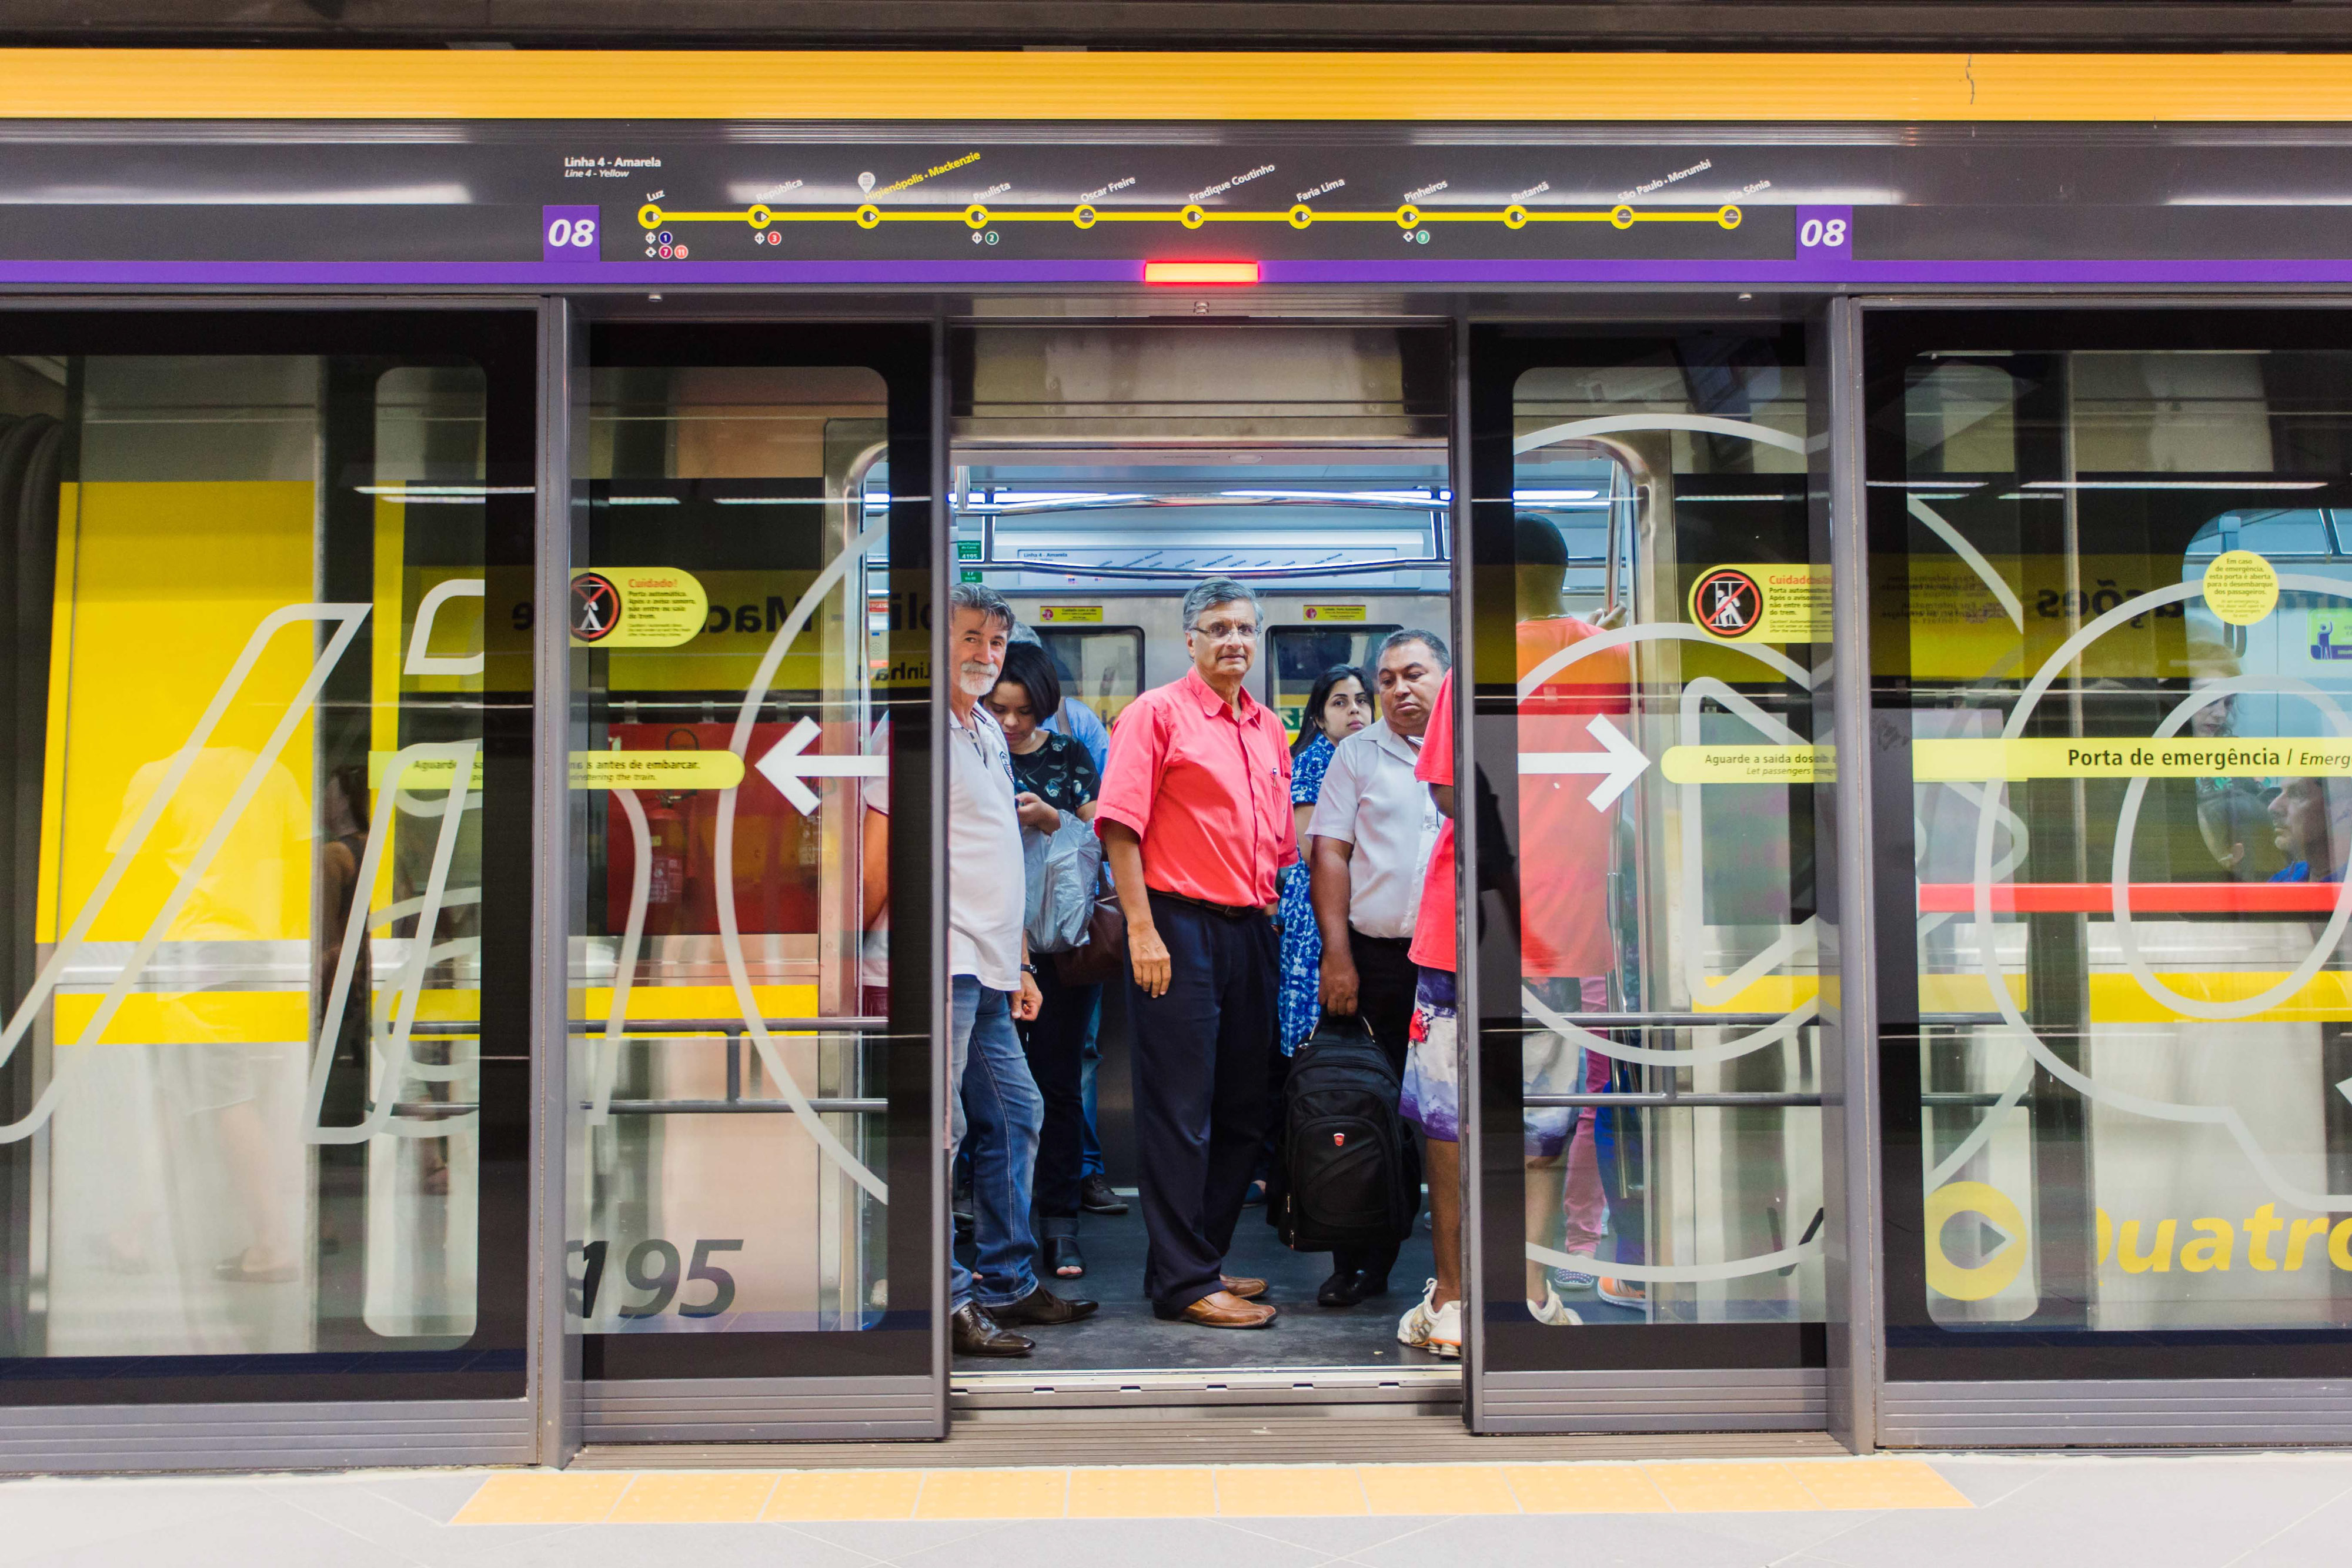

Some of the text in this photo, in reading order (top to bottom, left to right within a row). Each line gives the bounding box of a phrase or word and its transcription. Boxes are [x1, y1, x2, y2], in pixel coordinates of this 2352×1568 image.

[564, 157, 596, 168] Linha
[597, 158, 605, 168] 4
[614, 157, 662, 168] Amarela
[564, 169, 583, 178] Line
[585, 169, 592, 178] 4
[599, 169, 630, 178] Yellow
[864, 174, 924, 202] Higienópolis
[928, 152, 981, 177] Mackenzie
[1188, 163, 1275, 202] Fradique Coutinho
[1617, 188, 1636, 203] São
[1636, 179, 1663, 196] Paulo
[1668, 159, 1712, 183] Morumbi
[1741, 179, 1771, 197] Sônia
[646, 189, 666, 202] Luz
[756, 178, 804, 202] República
[973, 182, 1011, 202] Paulista
[1080, 176, 1136, 203] Oscar Freire
[1295, 178, 1345, 202] Faria Lima
[1403, 180, 1448, 202] Pinheiros
[1511, 180, 1549, 203] Butantã
[548, 219, 596, 246] 08
[1800, 220, 1846, 246] 08
[628, 579, 678, 588] Cuidado!
[596, 760, 626, 770] antes
[629, 759, 642, 770] de
[646, 759, 701, 770] embarcar.
[1705, 754, 1753, 766] Aguarde
[1795, 754, 1813, 764] dos
[2068, 748, 2123, 766] Porta
[2130, 748, 2154, 766] de
[2161, 748, 2280, 770] emergência
[2287, 748, 2293, 766] /
